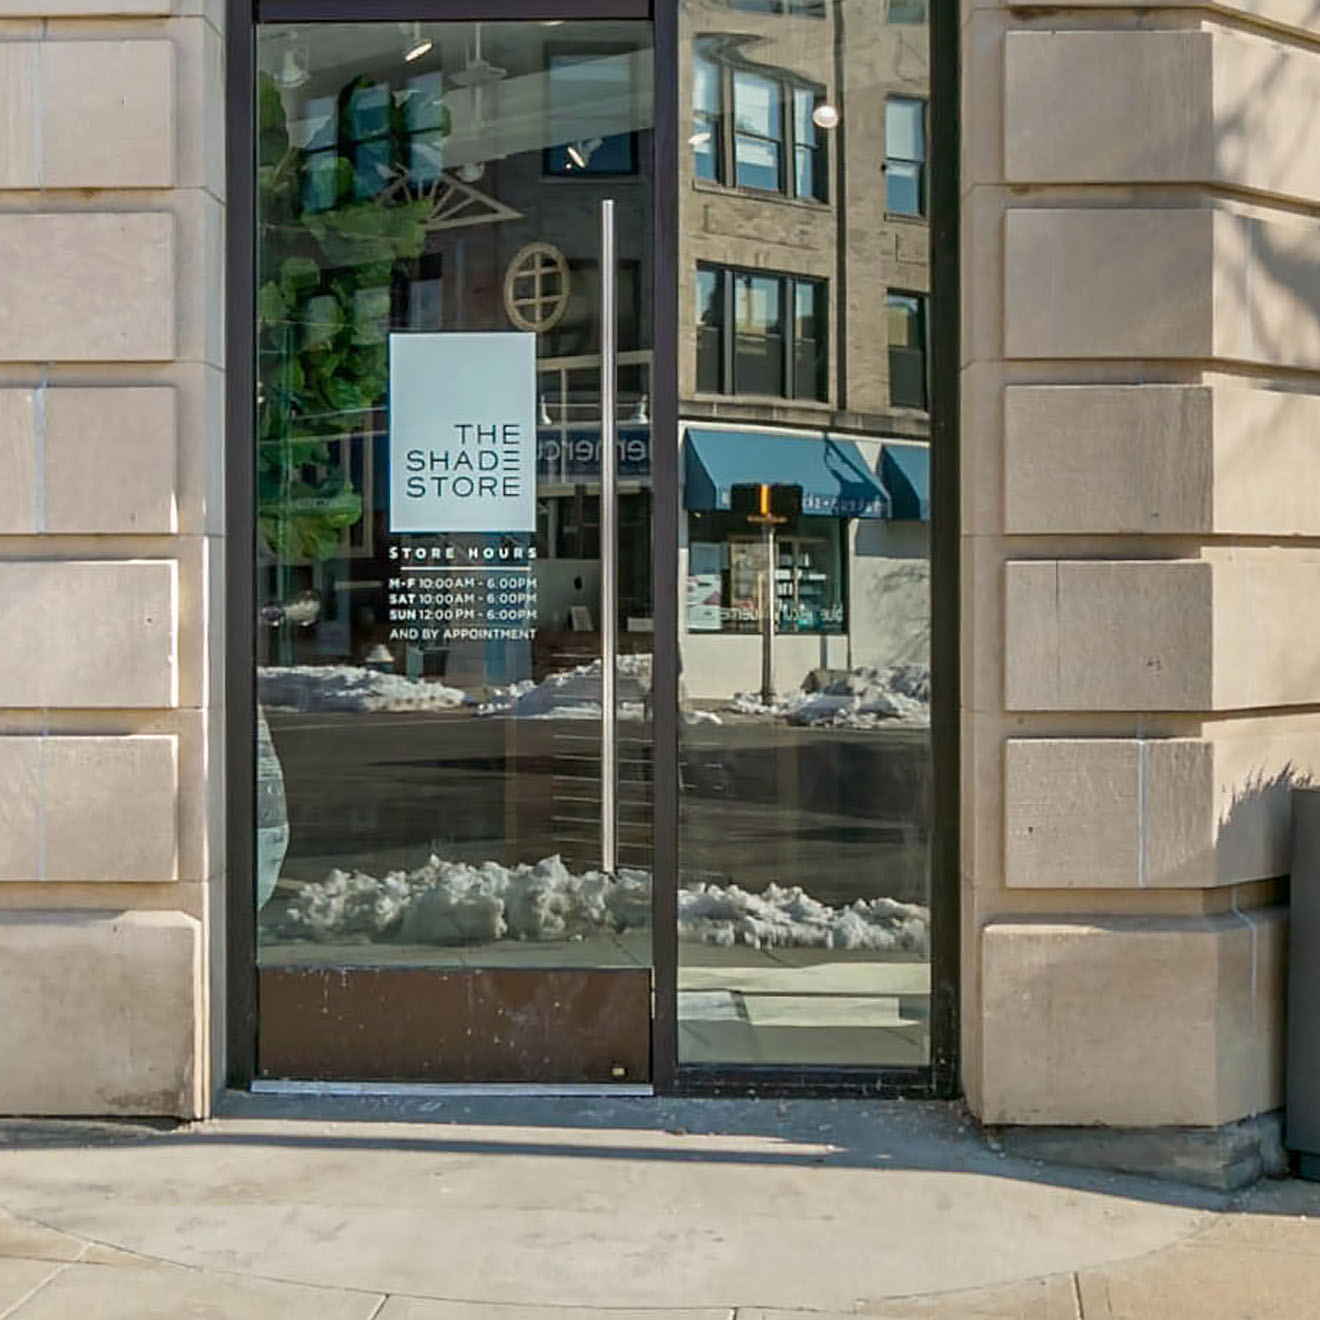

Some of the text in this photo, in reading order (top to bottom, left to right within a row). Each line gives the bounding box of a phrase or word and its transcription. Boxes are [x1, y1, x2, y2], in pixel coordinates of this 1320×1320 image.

[453, 424, 521, 445] THE
[406, 449, 521, 472] SHADE
[406, 475, 521, 498] STORE
[388, 547, 538, 560] STORE HOURS
[388, 593, 417, 605] SAT
[388, 609, 417, 620] SUN
[389, 628, 537, 640] AND BY APPOINTMENT
